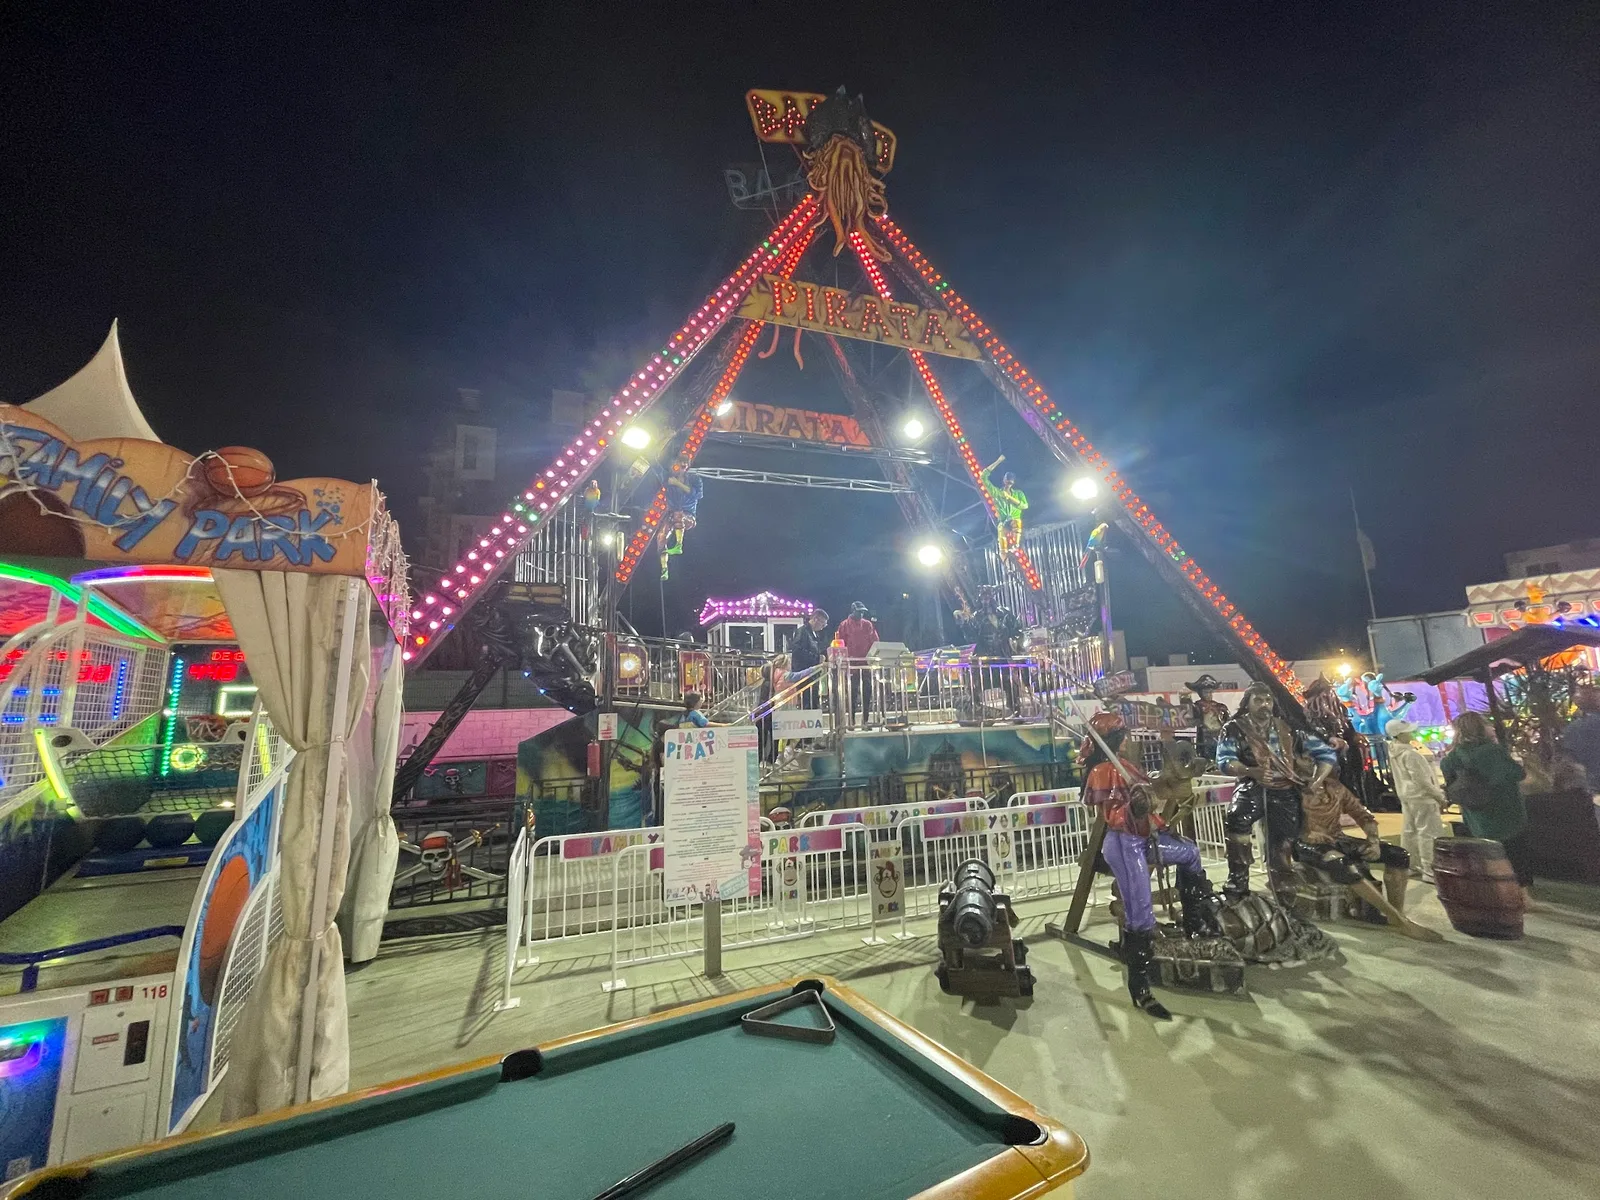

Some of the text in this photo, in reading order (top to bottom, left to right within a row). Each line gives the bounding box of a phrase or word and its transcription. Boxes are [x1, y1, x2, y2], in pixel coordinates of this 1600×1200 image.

[771, 278, 957, 352] PIRATA
[716, 402, 850, 443] IRATA
[174, 508, 338, 567] PARK
[773, 719, 823, 730] ENTRADA
[678, 730, 715, 744] BARCO
[769, 833, 811, 855] PARK
[142, 984, 168, 1000] 118
